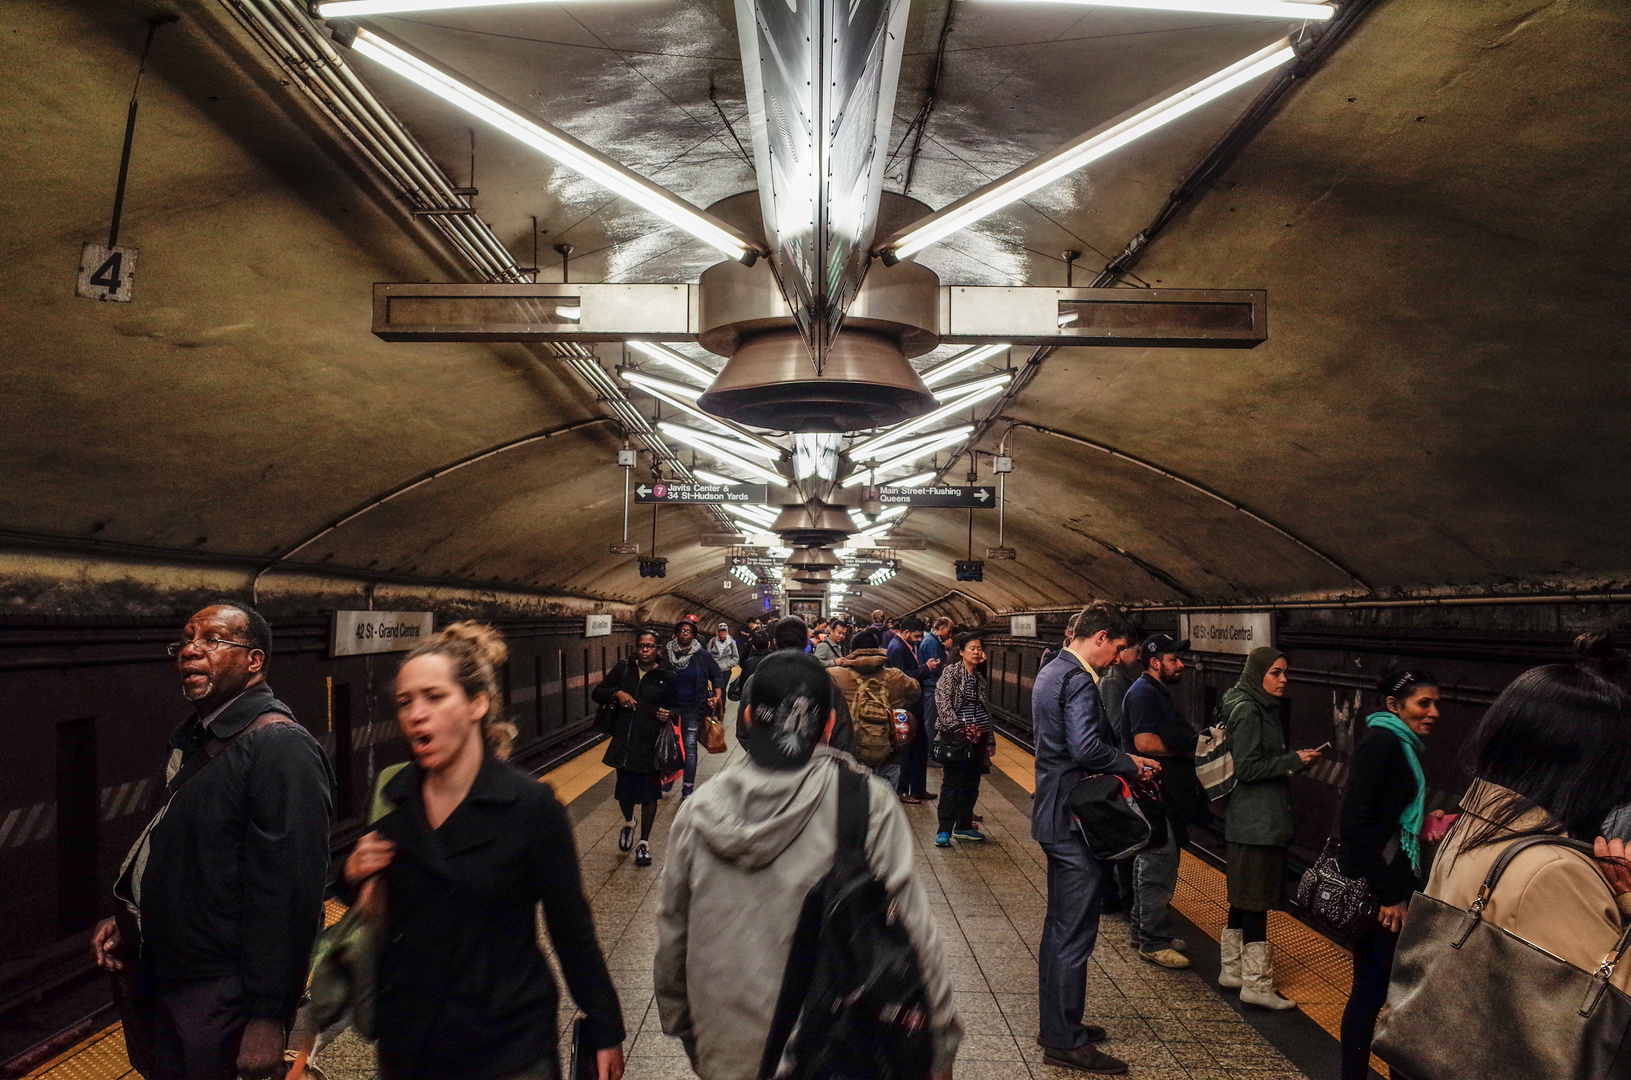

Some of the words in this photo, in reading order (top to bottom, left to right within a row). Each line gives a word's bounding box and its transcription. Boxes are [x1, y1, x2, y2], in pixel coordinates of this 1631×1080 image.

[90, 252, 122, 294] 4
[657, 487, 663, 495] 7
[667, 484, 691, 492] Javits
[693, 484, 720, 492] Center
[723, 484, 730, 492] &
[880, 486, 899, 495] Main
[901, 486, 962, 497] Street-Flushing
[667, 492, 678, 500] 34
[681, 492, 724, 500] St-Hudson
[727, 492, 749, 500] Yards
[880, 494, 911, 503] Queens
[356, 623, 365, 639] 42
[366, 623, 374, 639] St
[379, 622, 399, 638] Grand
[400, 622, 420, 637] Central
[1210, 625, 1229, 640] Grand
[1229, 625, 1253, 641] Central
